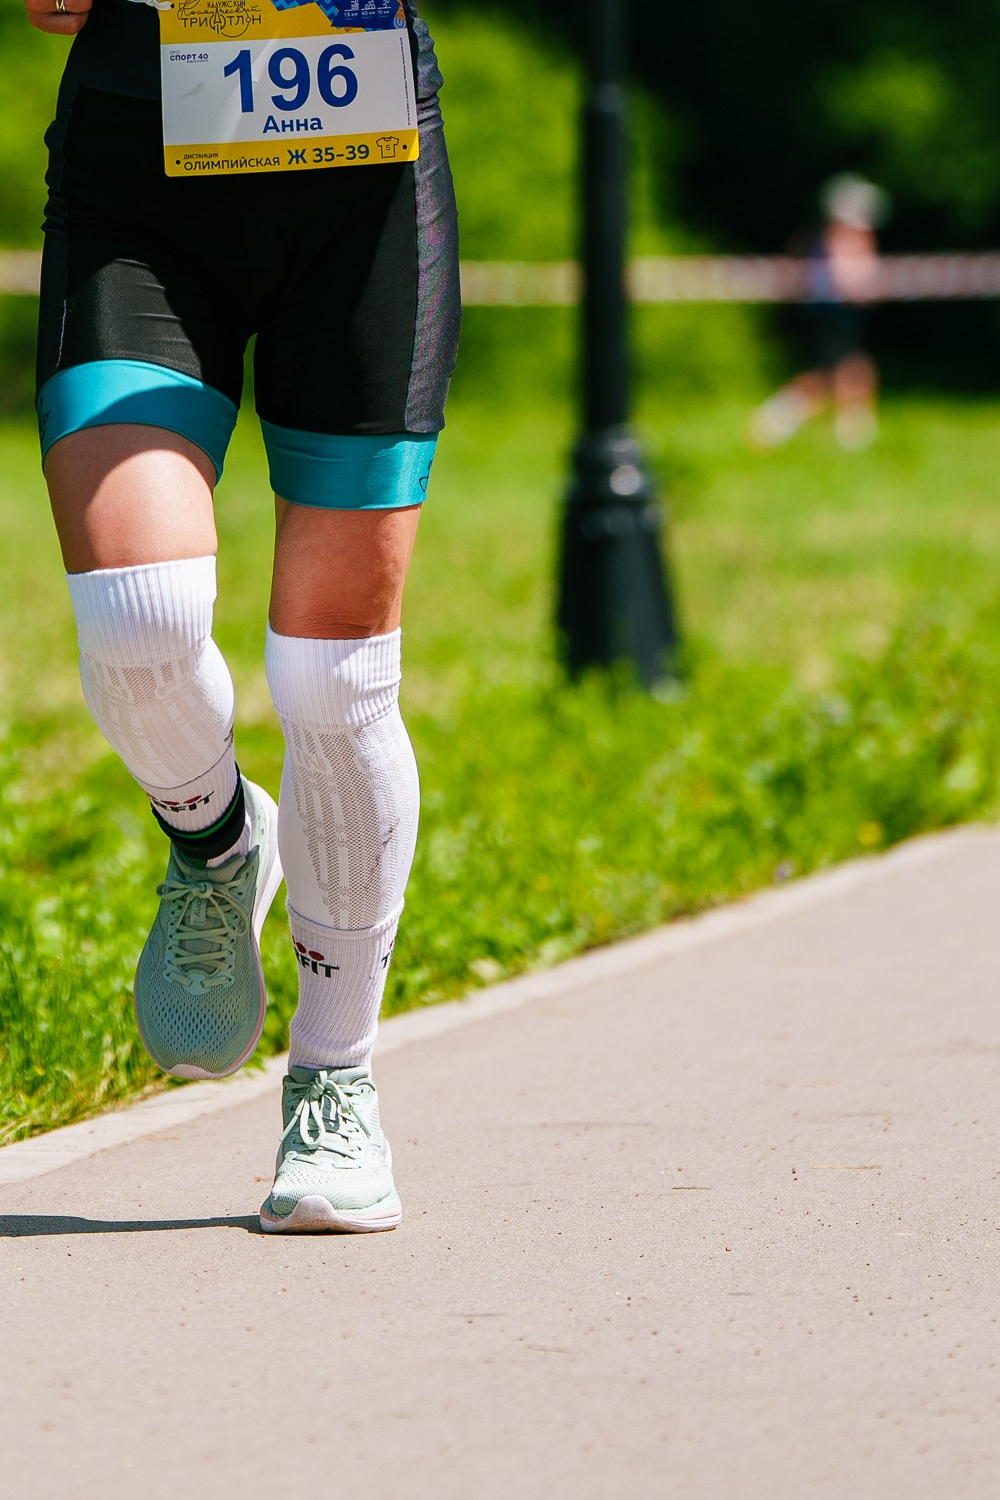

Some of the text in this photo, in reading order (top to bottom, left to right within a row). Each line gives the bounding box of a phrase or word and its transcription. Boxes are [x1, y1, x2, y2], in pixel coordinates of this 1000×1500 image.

[182, 11, 262, 31] ТРИАТЛОН
[223, 43, 359, 113] 196
[262, 115, 323, 134] Анна
[183, 156, 280, 171] ОЛИМПИЙСКАЯ
[287, 144, 370, 165] Ж 35-39
